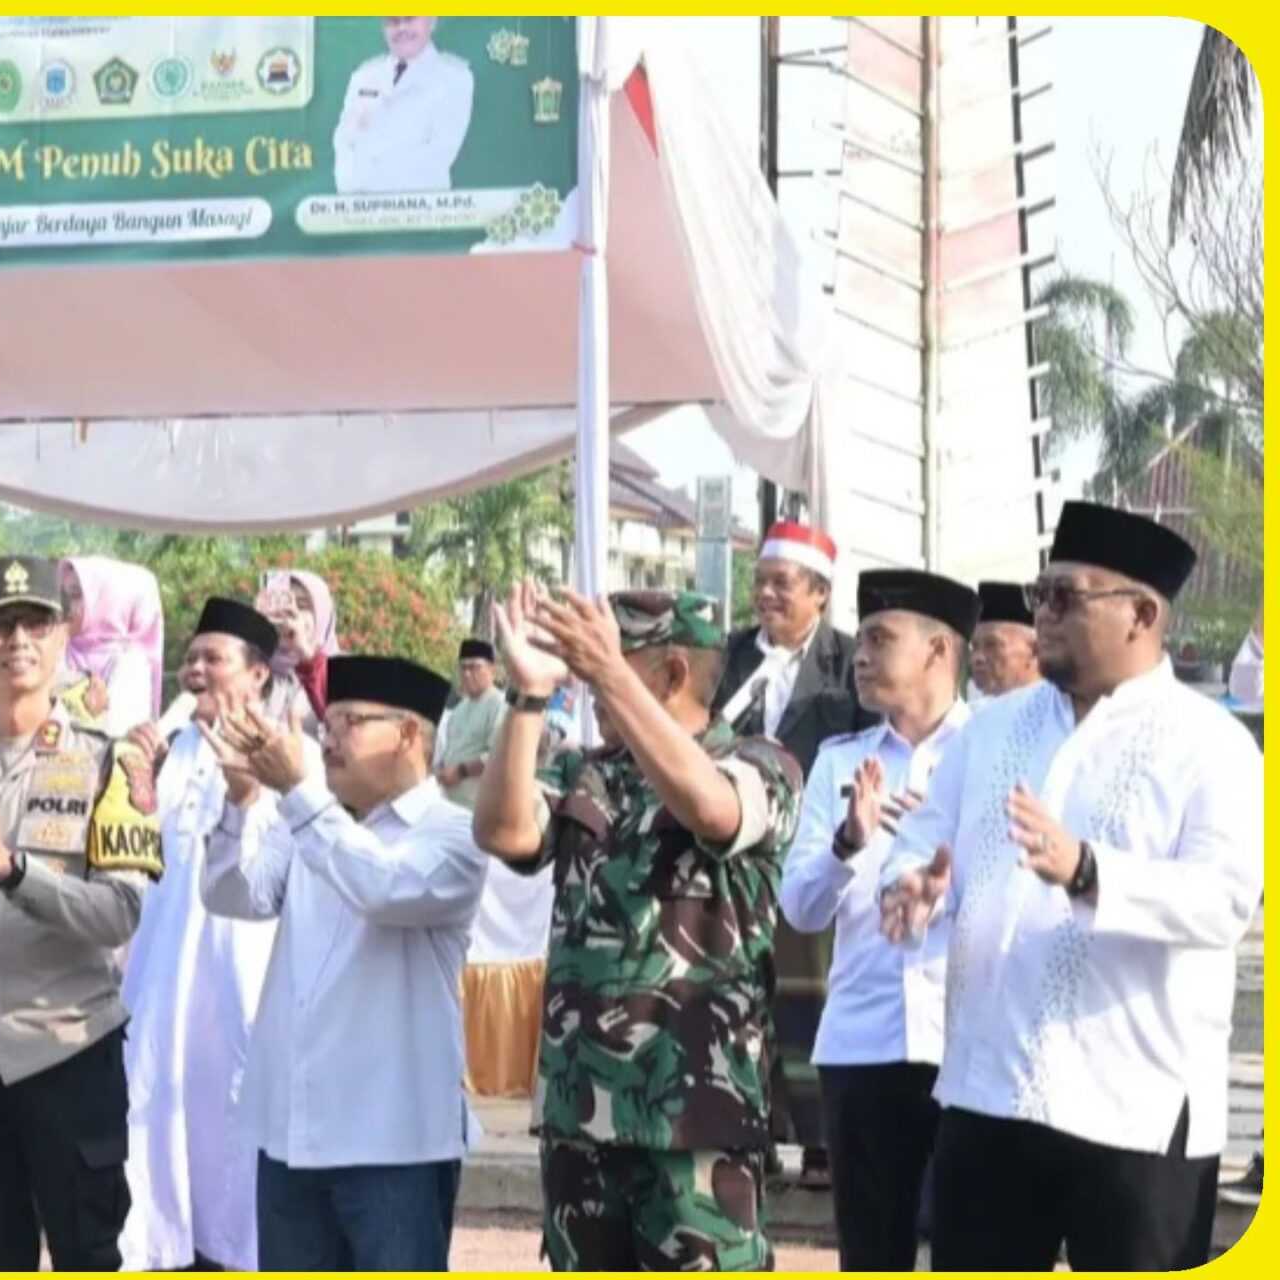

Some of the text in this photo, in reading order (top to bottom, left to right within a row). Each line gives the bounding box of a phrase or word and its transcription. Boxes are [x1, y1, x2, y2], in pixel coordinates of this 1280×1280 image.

[34, 141, 142, 181] Penuh
[150, 136, 234, 180] Suka
[244, 135, 313, 176] Cita
[35, 212, 108, 238] Berdaya
[111, 210, 183, 235] Bangun
[27, 796, 88, 817] POLRI
